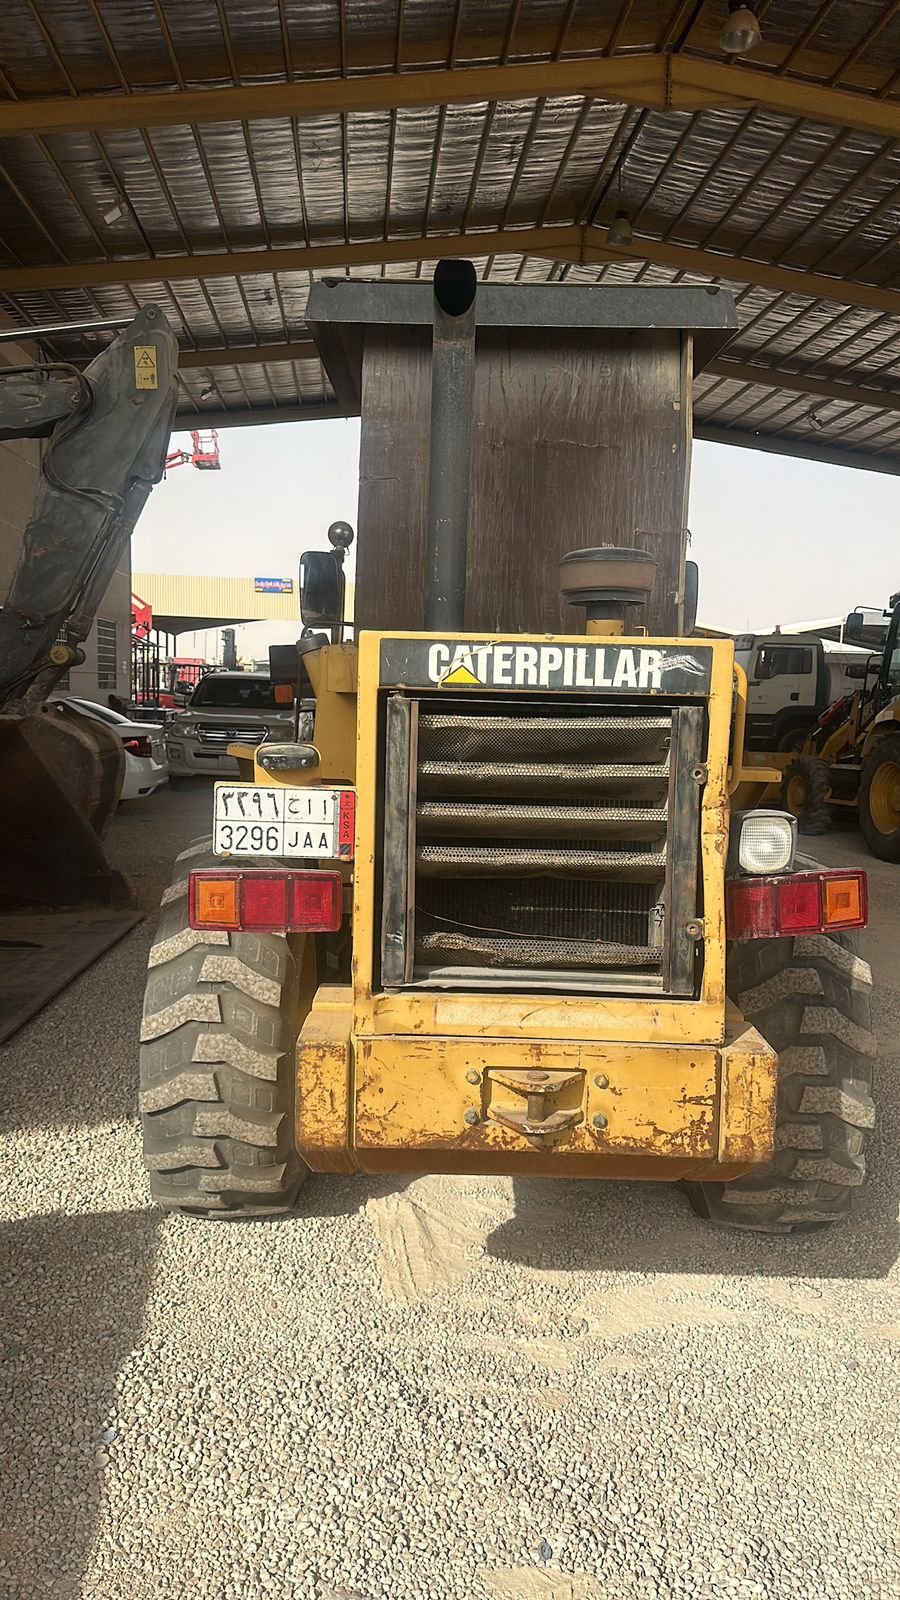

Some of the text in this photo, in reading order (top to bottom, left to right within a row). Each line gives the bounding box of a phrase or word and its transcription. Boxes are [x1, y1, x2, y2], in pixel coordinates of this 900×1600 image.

[428, 643, 662, 689] CATERPILLAR
[220, 825, 279, 851] 3296
[342, 812, 350, 839] KSA
